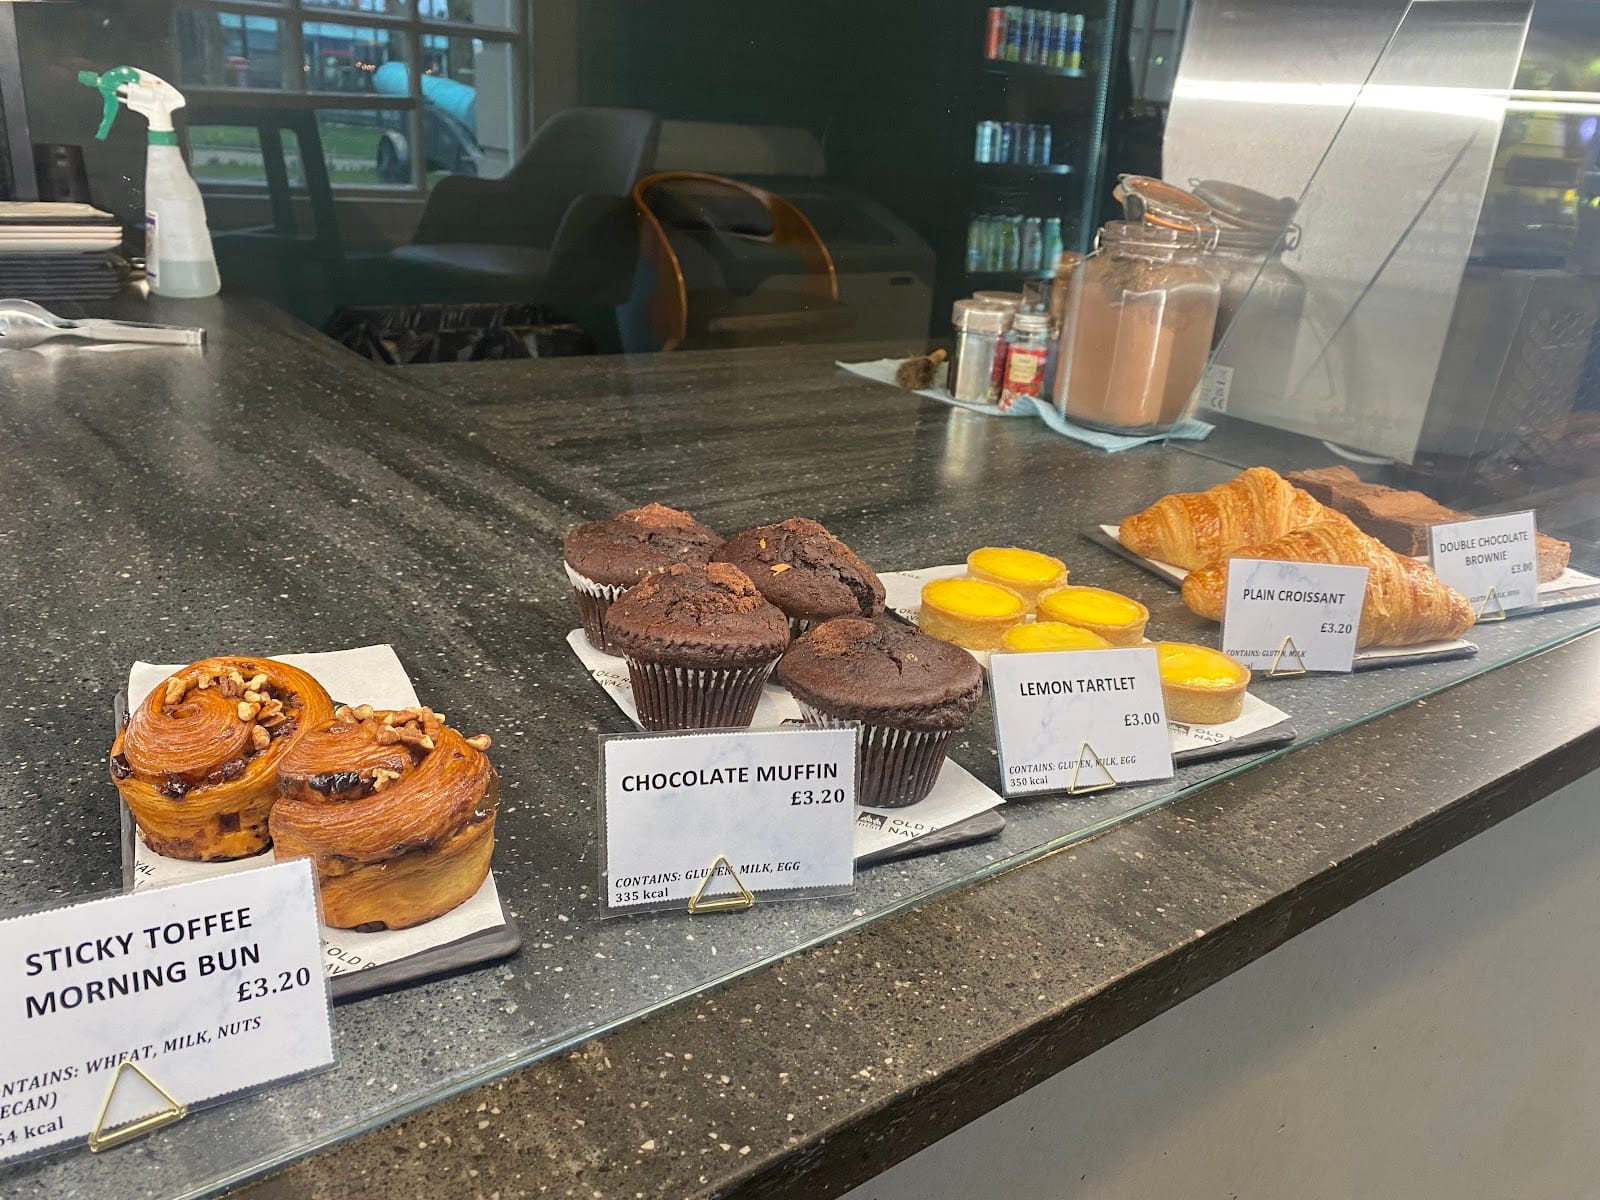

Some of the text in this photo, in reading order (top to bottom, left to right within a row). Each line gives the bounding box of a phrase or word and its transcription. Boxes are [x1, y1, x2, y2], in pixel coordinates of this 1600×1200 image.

[1440, 531, 1529, 553] DOUBLE CHOCOLATE
[1465, 550, 1508, 566] BROWNIE
[1243, 588, 1346, 605] PLAIN CROISSANT
[1320, 622, 1352, 634] £3.20
[1020, 677, 1136, 696] LEMON TARTLET
[1124, 712, 1160, 727] £3.00
[1009, 762, 1055, 775] CONTAINS:
[1120, 755, 1136, 765] EGG
[621, 763, 838, 792] CHOCOLATE MUFFIN
[1010, 776, 1048, 787] 350 kcal
[791, 788, 846, 806] £3.20
[892, 819, 924, 830] OLD
[615, 871, 681, 888] CONTAINS:
[740, 863, 773, 874] MILK,
[777, 861, 801, 872] EGG
[615, 887, 669, 903] 335 kcal
[25, 907, 252, 976] STICKY TOFFEE
[327, 947, 362, 965] OLD
[25, 943, 260, 1019] MORNING BUN
[236, 966, 311, 1003] £3.20
[163, 1030, 212, 1054] MILK,
[217, 1016, 262, 1039] NUTS
[24, 1115, 64, 1139] kcal
